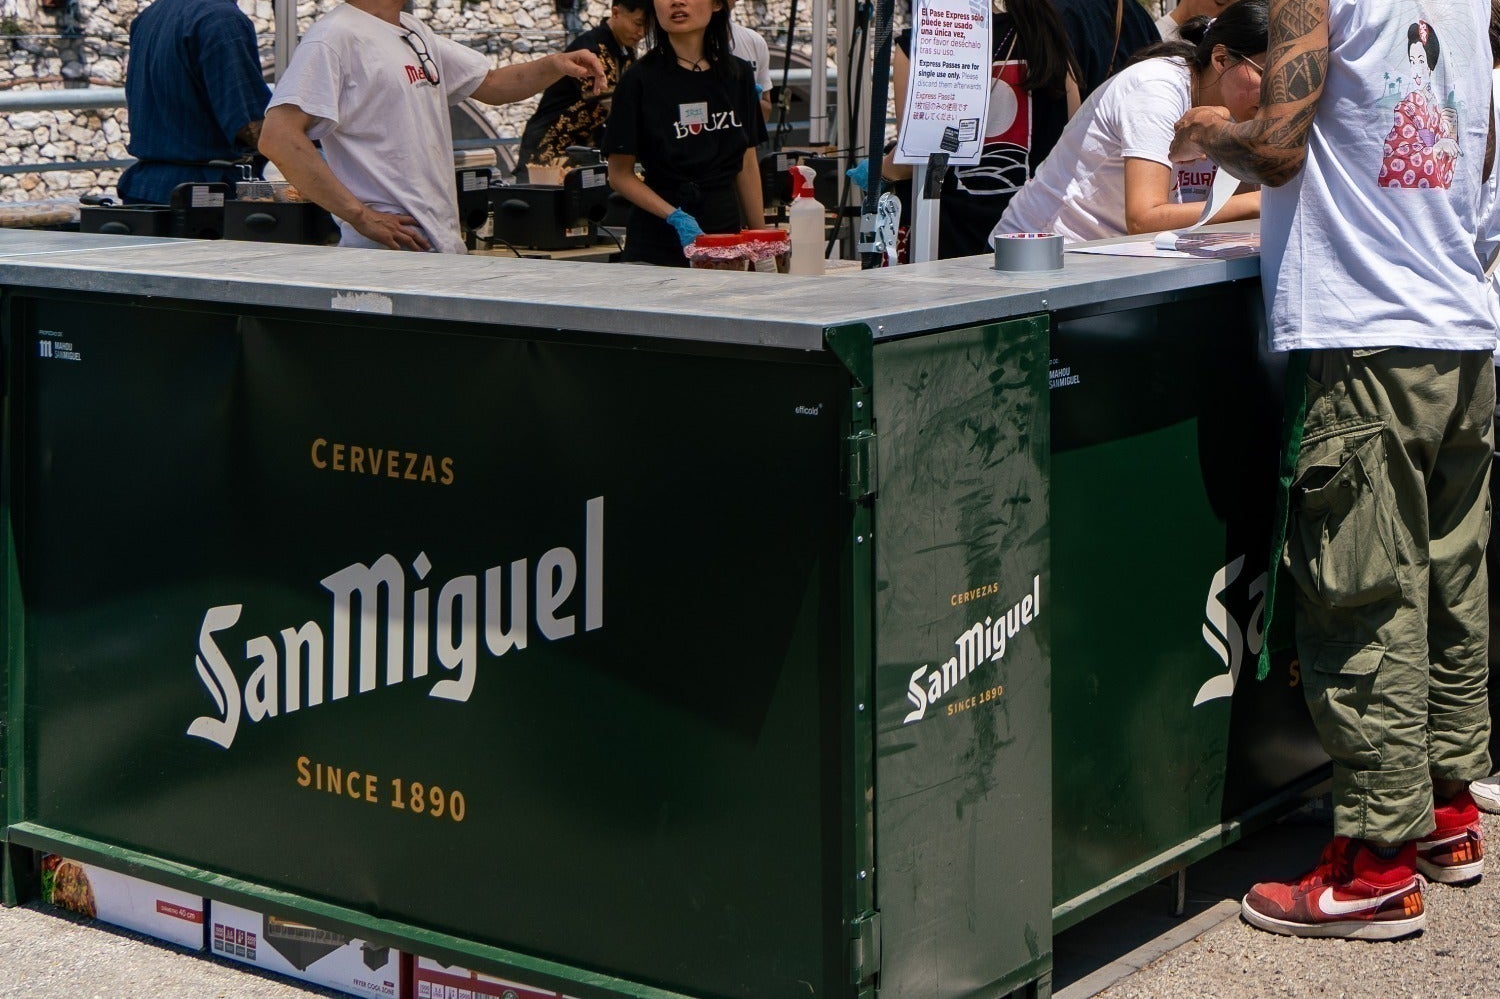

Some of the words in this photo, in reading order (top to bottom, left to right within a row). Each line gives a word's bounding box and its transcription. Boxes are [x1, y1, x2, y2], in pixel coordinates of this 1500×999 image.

[921, 8, 927, 16] El
[930, 9, 944, 18] Pase
[945, 11, 970, 20] Express
[971, 13, 984, 22] sólo
[921, 18, 941, 27] puede
[954, 22, 973, 30] usado
[921, 28, 932, 36] una
[934, 28, 951, 37] única
[953, 31, 966, 39] vez,
[920, 37, 932, 45] por
[933, 37, 949, 46] favor
[920, 47, 932, 55] tras
[919, 59, 941, 68] Express
[942, 61, 961, 69] Passes
[918, 70, 936, 78] single
[947, 71, 961, 80] only.
[915, 91, 937, 101] Express
[1049, 366, 1071, 379] MAHOU
[1049, 374, 1081, 389] SANMIGUEL
[310, 437, 456, 486] CERVEZAS
[951, 581, 999, 607] CERVEZAS
[186, 495, 605, 750] SanMiguel
[903, 574, 1041, 724] SanMiguel
[947, 696, 978, 717] SINCE
[979, 685, 1004, 705] 1890
[296, 755, 379, 803] SINCE
[391, 777, 467, 822] 1890
[186, 911, 196, 920] cm
